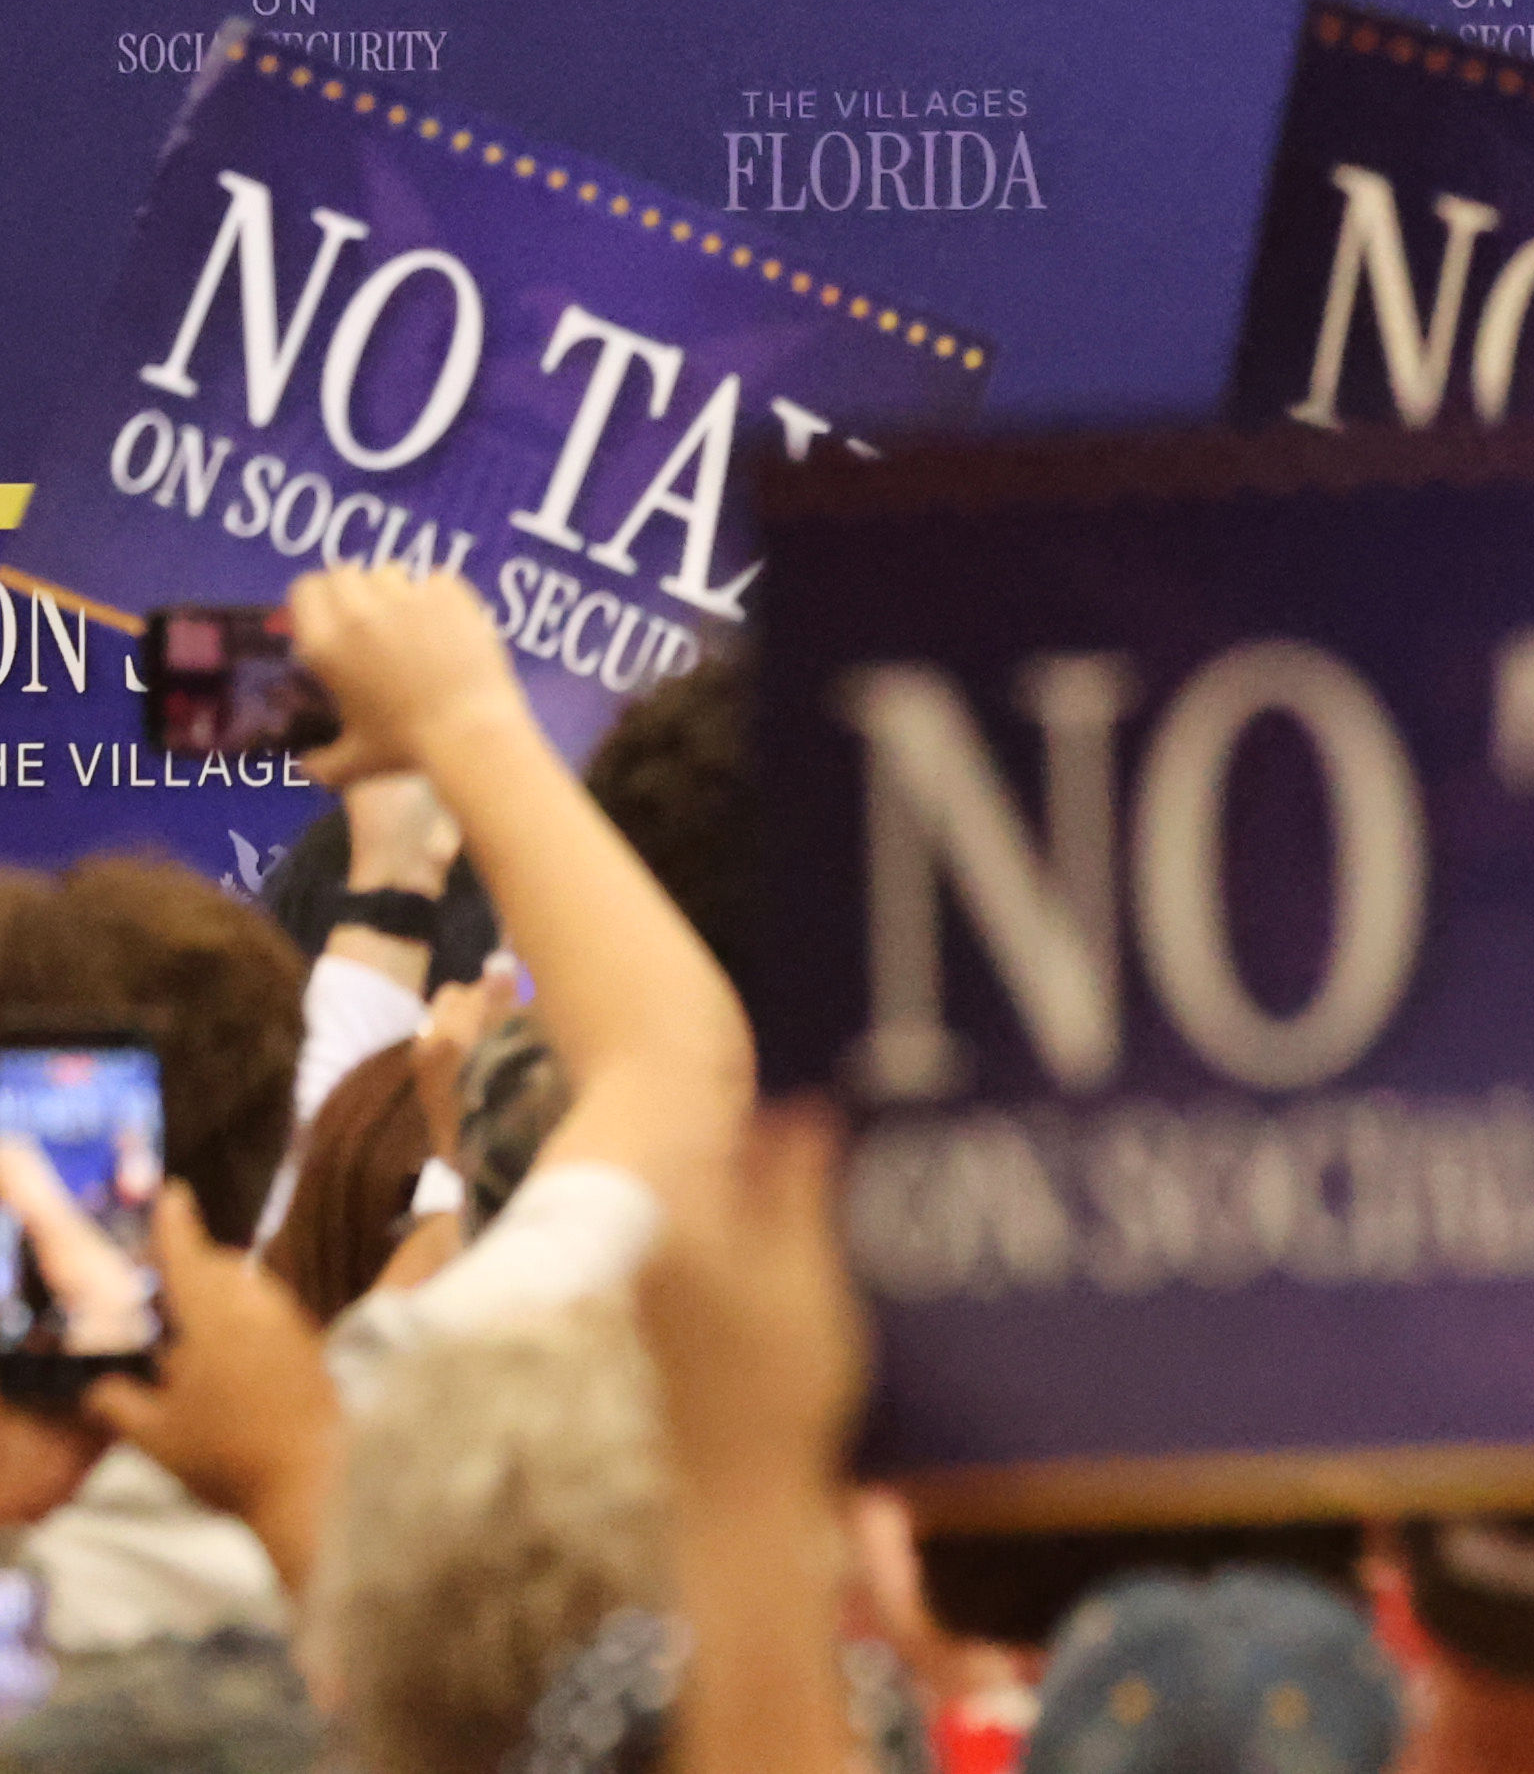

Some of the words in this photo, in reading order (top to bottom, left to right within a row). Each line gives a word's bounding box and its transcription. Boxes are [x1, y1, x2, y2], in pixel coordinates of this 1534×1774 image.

[117, 32, 210, 74] SOCI
[742, 91, 815, 119] THE
[834, 89, 1027, 118] VILLAGES
[724, 131, 1046, 211] FLORIDA
[140, 169, 483, 472] NO
[510, 305, 882, 622] TA
[109, 408, 233, 518] ON
[68, 742, 311, 787] VILLAGE
[838, 638, 1432, 1094] NO
